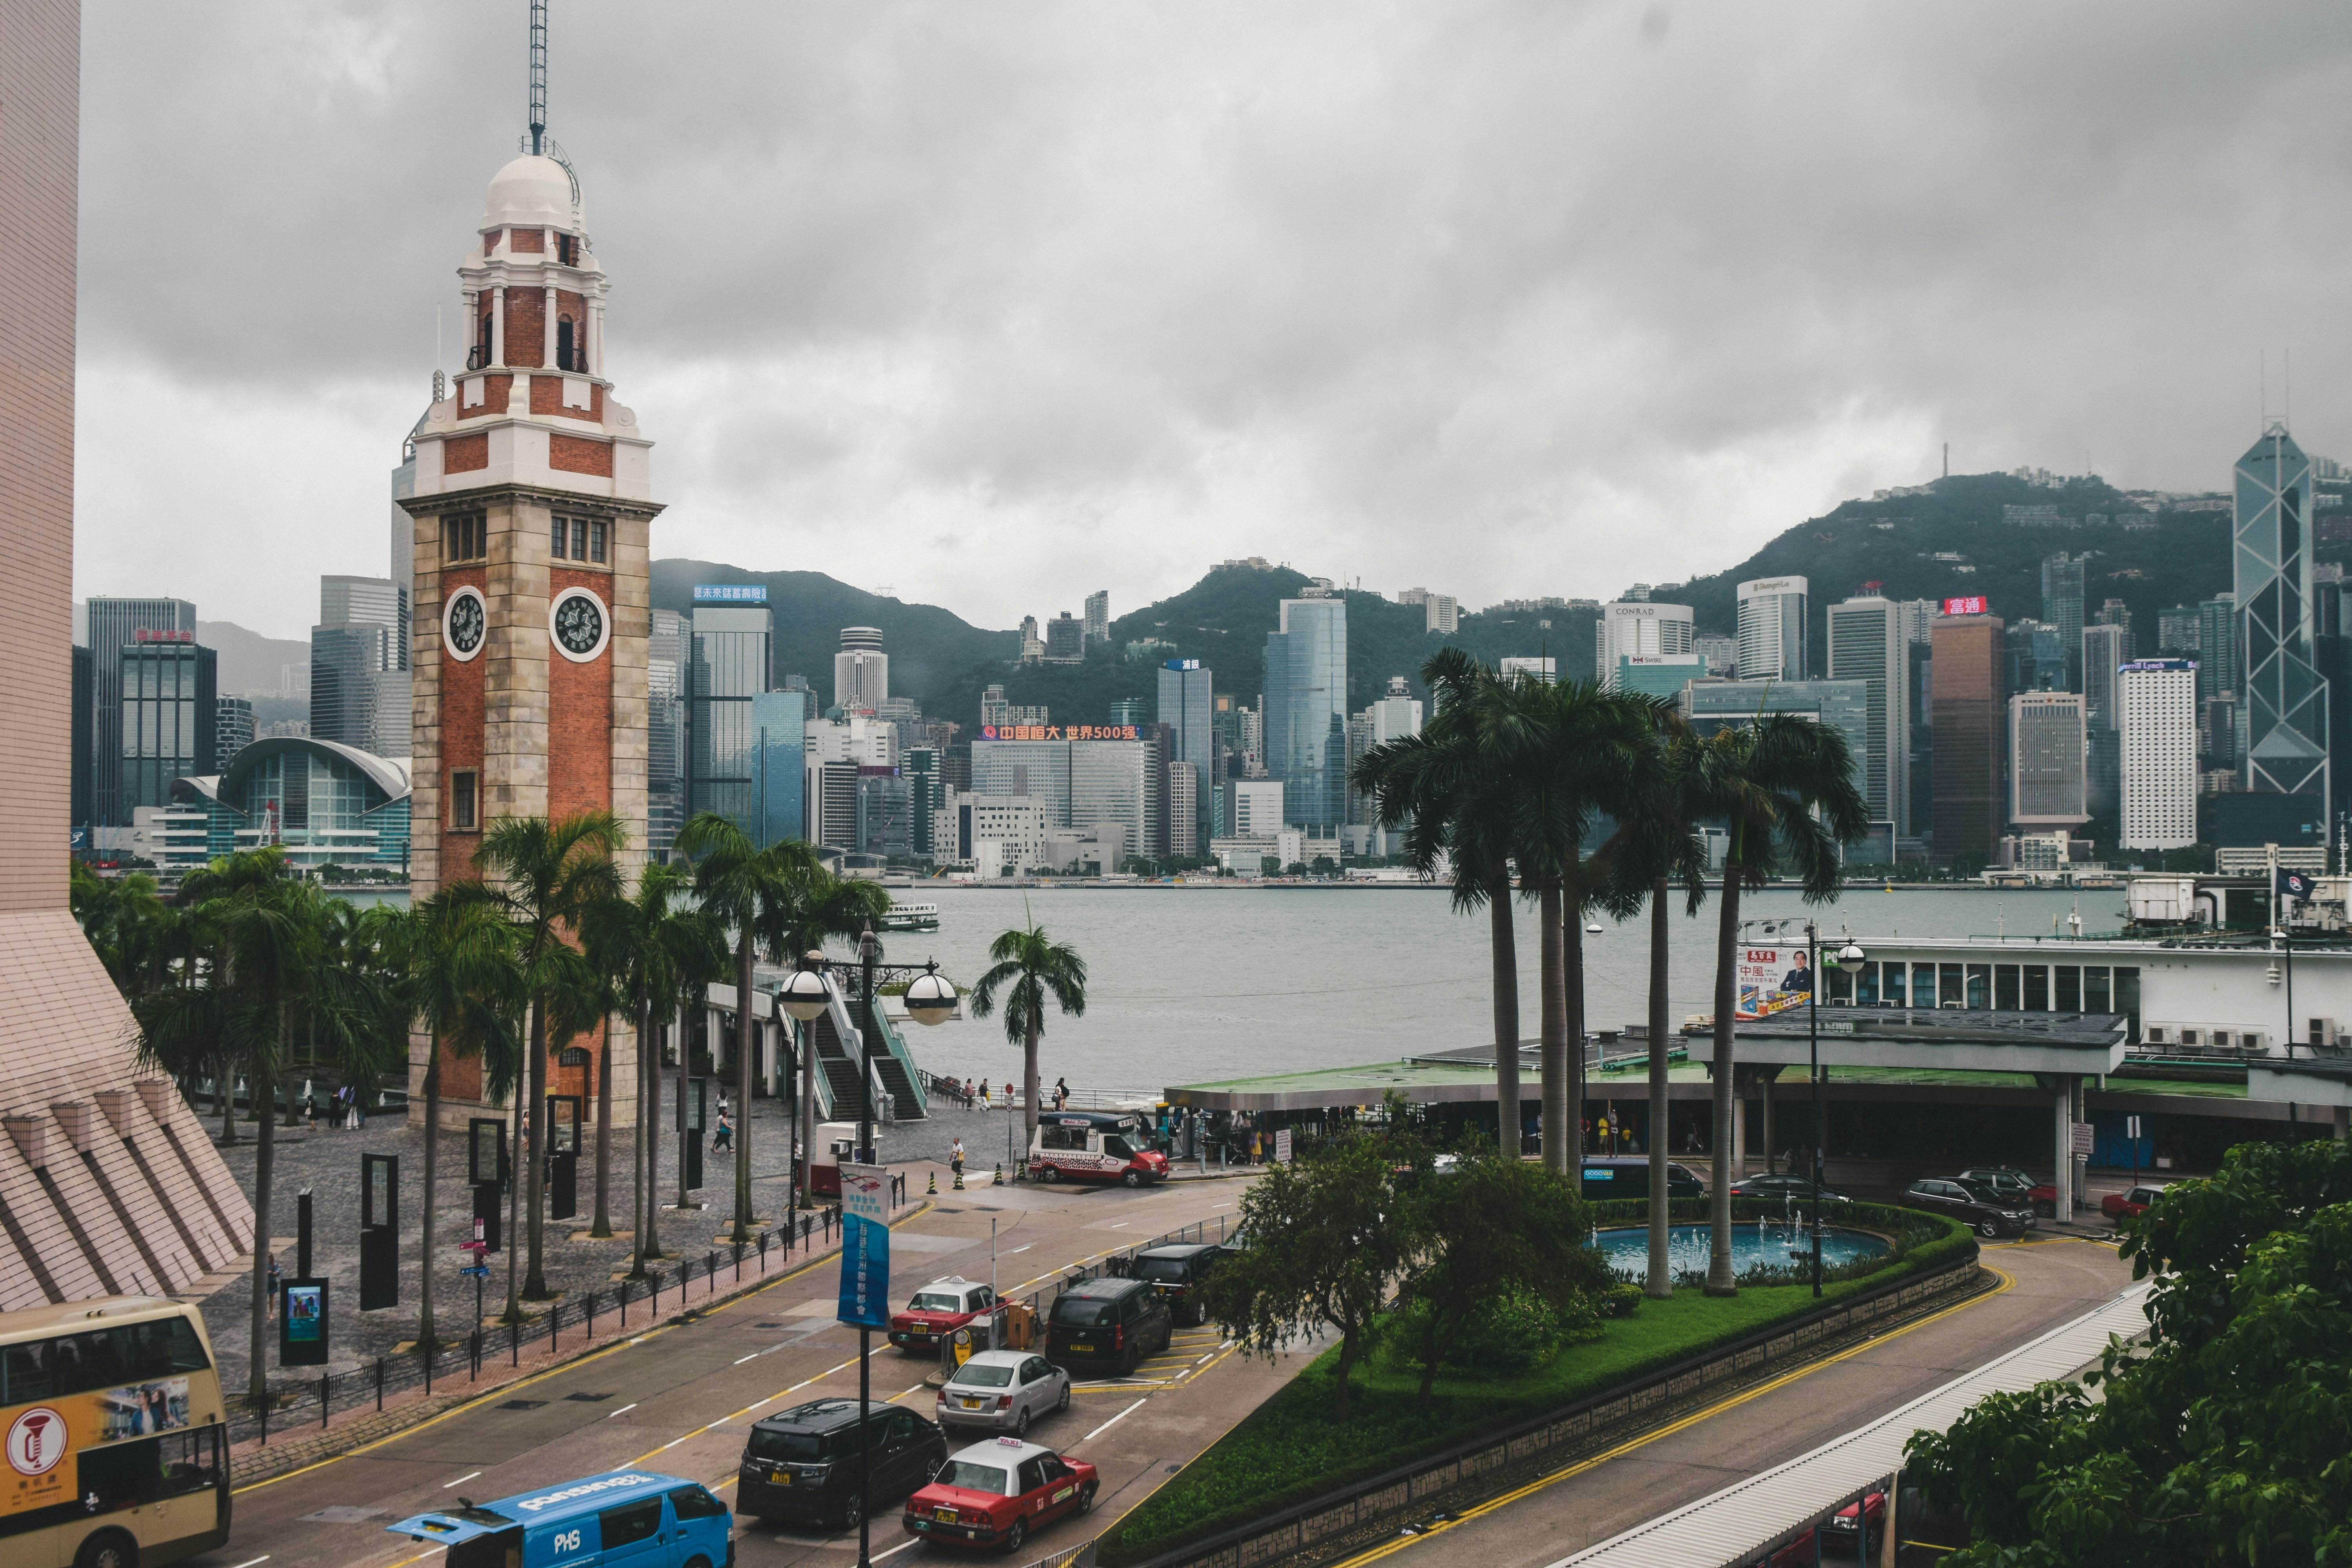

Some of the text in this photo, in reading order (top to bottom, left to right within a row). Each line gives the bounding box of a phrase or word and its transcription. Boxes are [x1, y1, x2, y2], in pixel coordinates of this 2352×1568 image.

[1950, 598, 1979, 614] 富通
[1183, 659, 1200, 669] 浦銀
[1000, 726, 1135, 740] 中国恒大 世界500强
[1751, 951, 1773, 960] 馬百良
[1740, 966, 1764, 976] 中風
